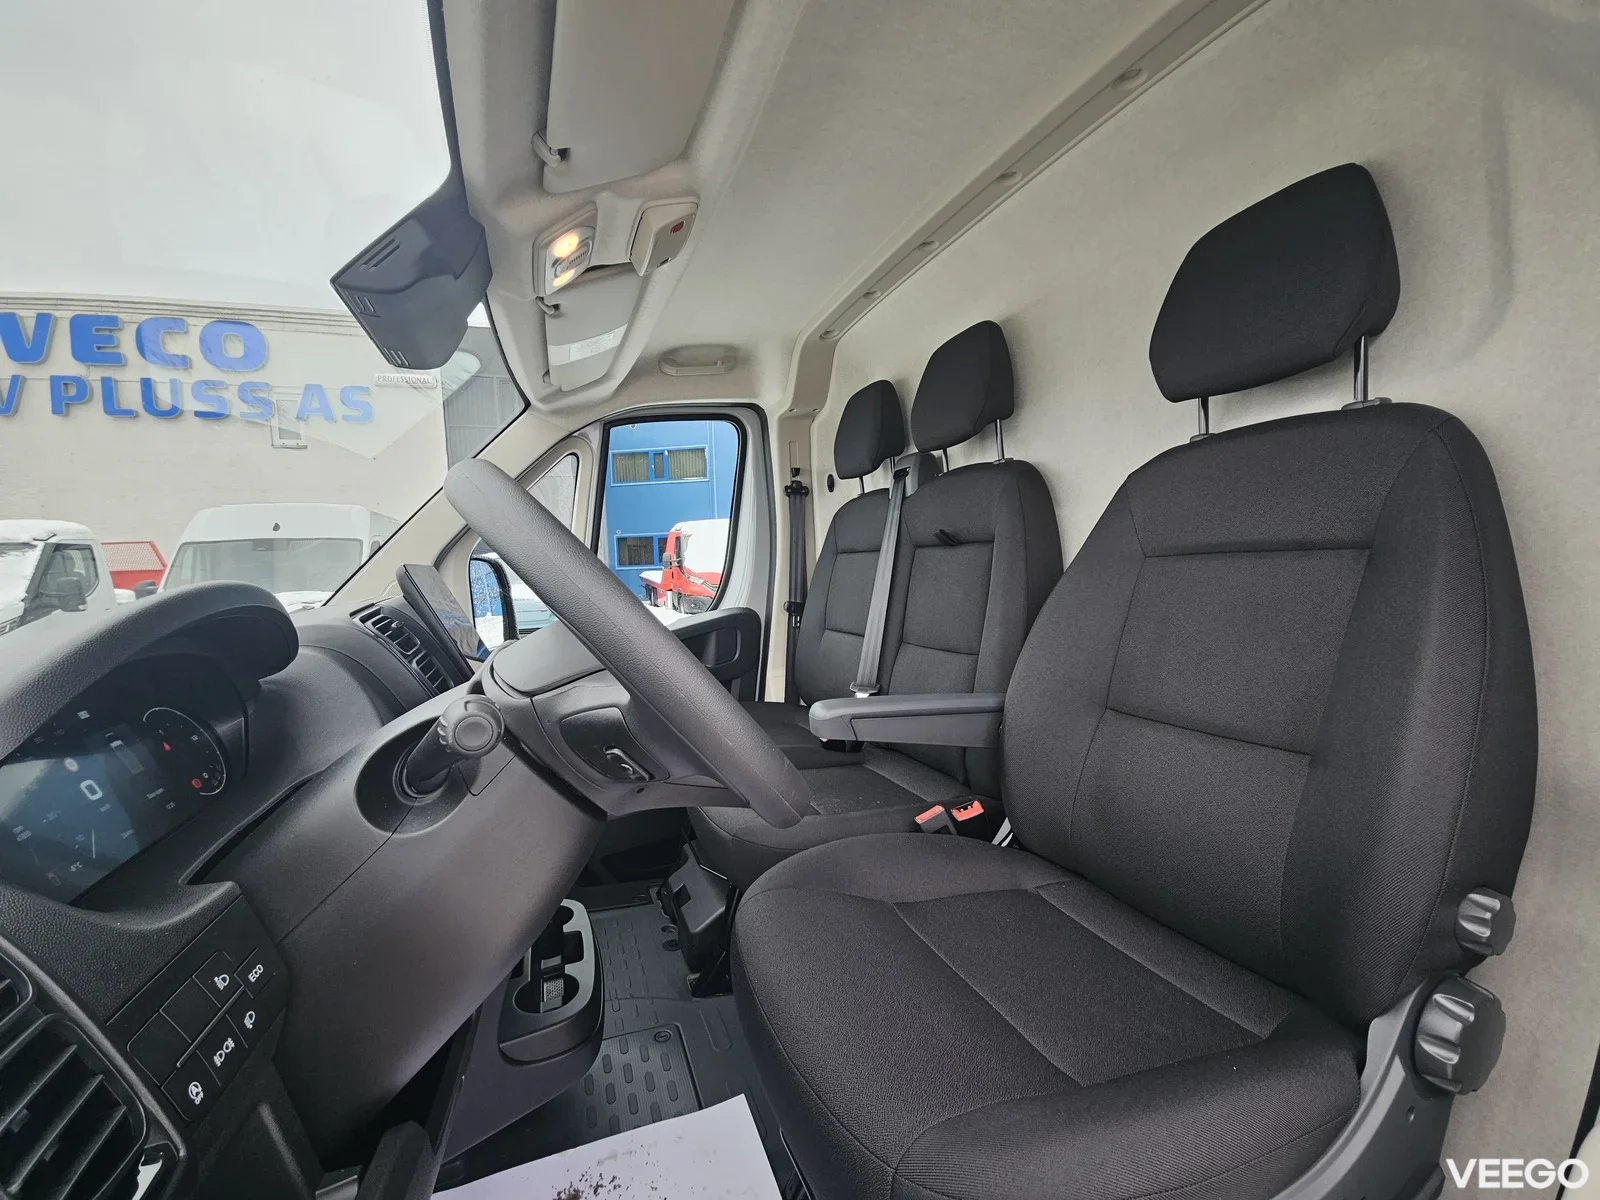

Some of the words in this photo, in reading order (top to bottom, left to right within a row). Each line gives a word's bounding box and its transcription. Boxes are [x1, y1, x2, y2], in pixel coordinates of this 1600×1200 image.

[0, 312, 269, 372] VECO
[377, 374, 432, 385] PROFESSIONAL
[49, 375, 277, 421] PLUSS
[295, 383, 374, 424] AS
[80, 780, 103, 800] 0
[248, 964, 264, 983] ECO
